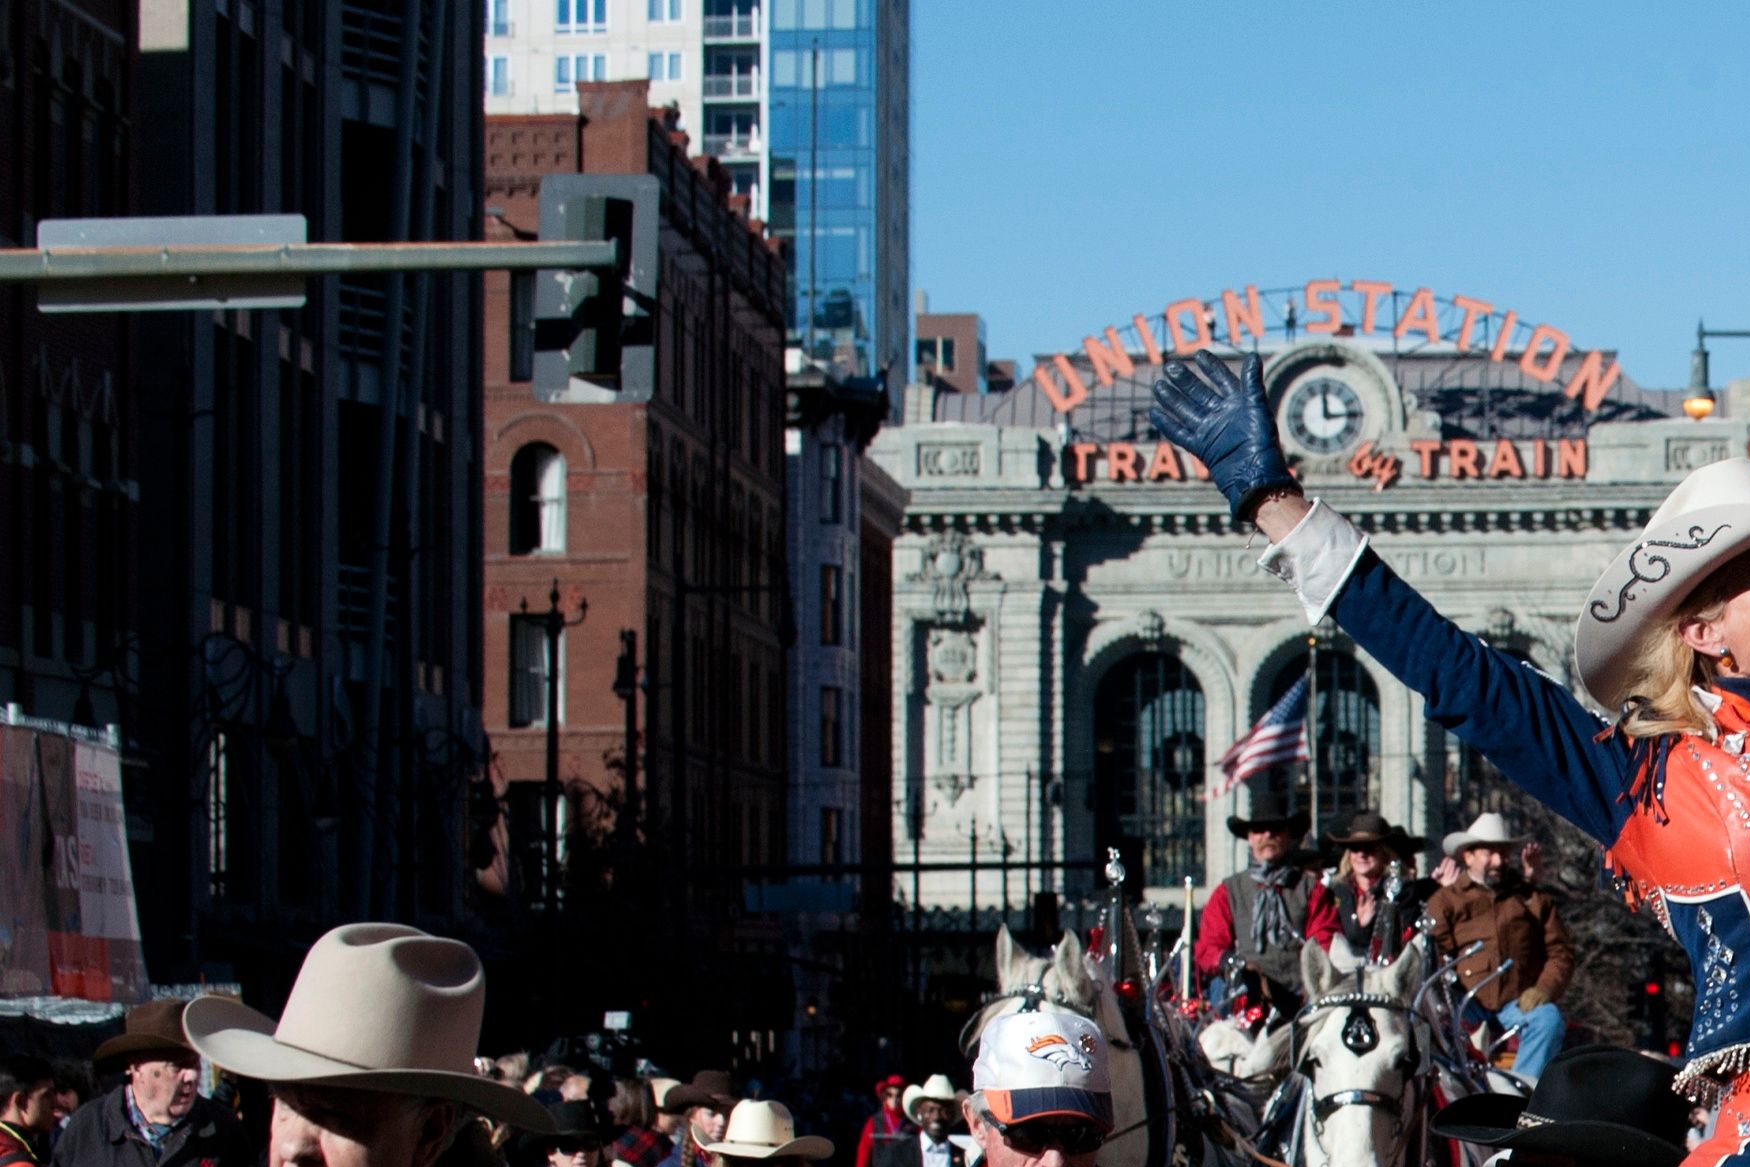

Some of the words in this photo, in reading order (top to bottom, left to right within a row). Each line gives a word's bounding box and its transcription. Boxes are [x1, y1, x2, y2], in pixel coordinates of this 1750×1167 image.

[1034, 284, 1265, 412] UNION
[1304, 278, 1622, 412] STATION
[1347, 440, 1397, 492] by
[1411, 438, 1587, 479] TRAIN
[1167, 551, 1262, 578] UNIO
